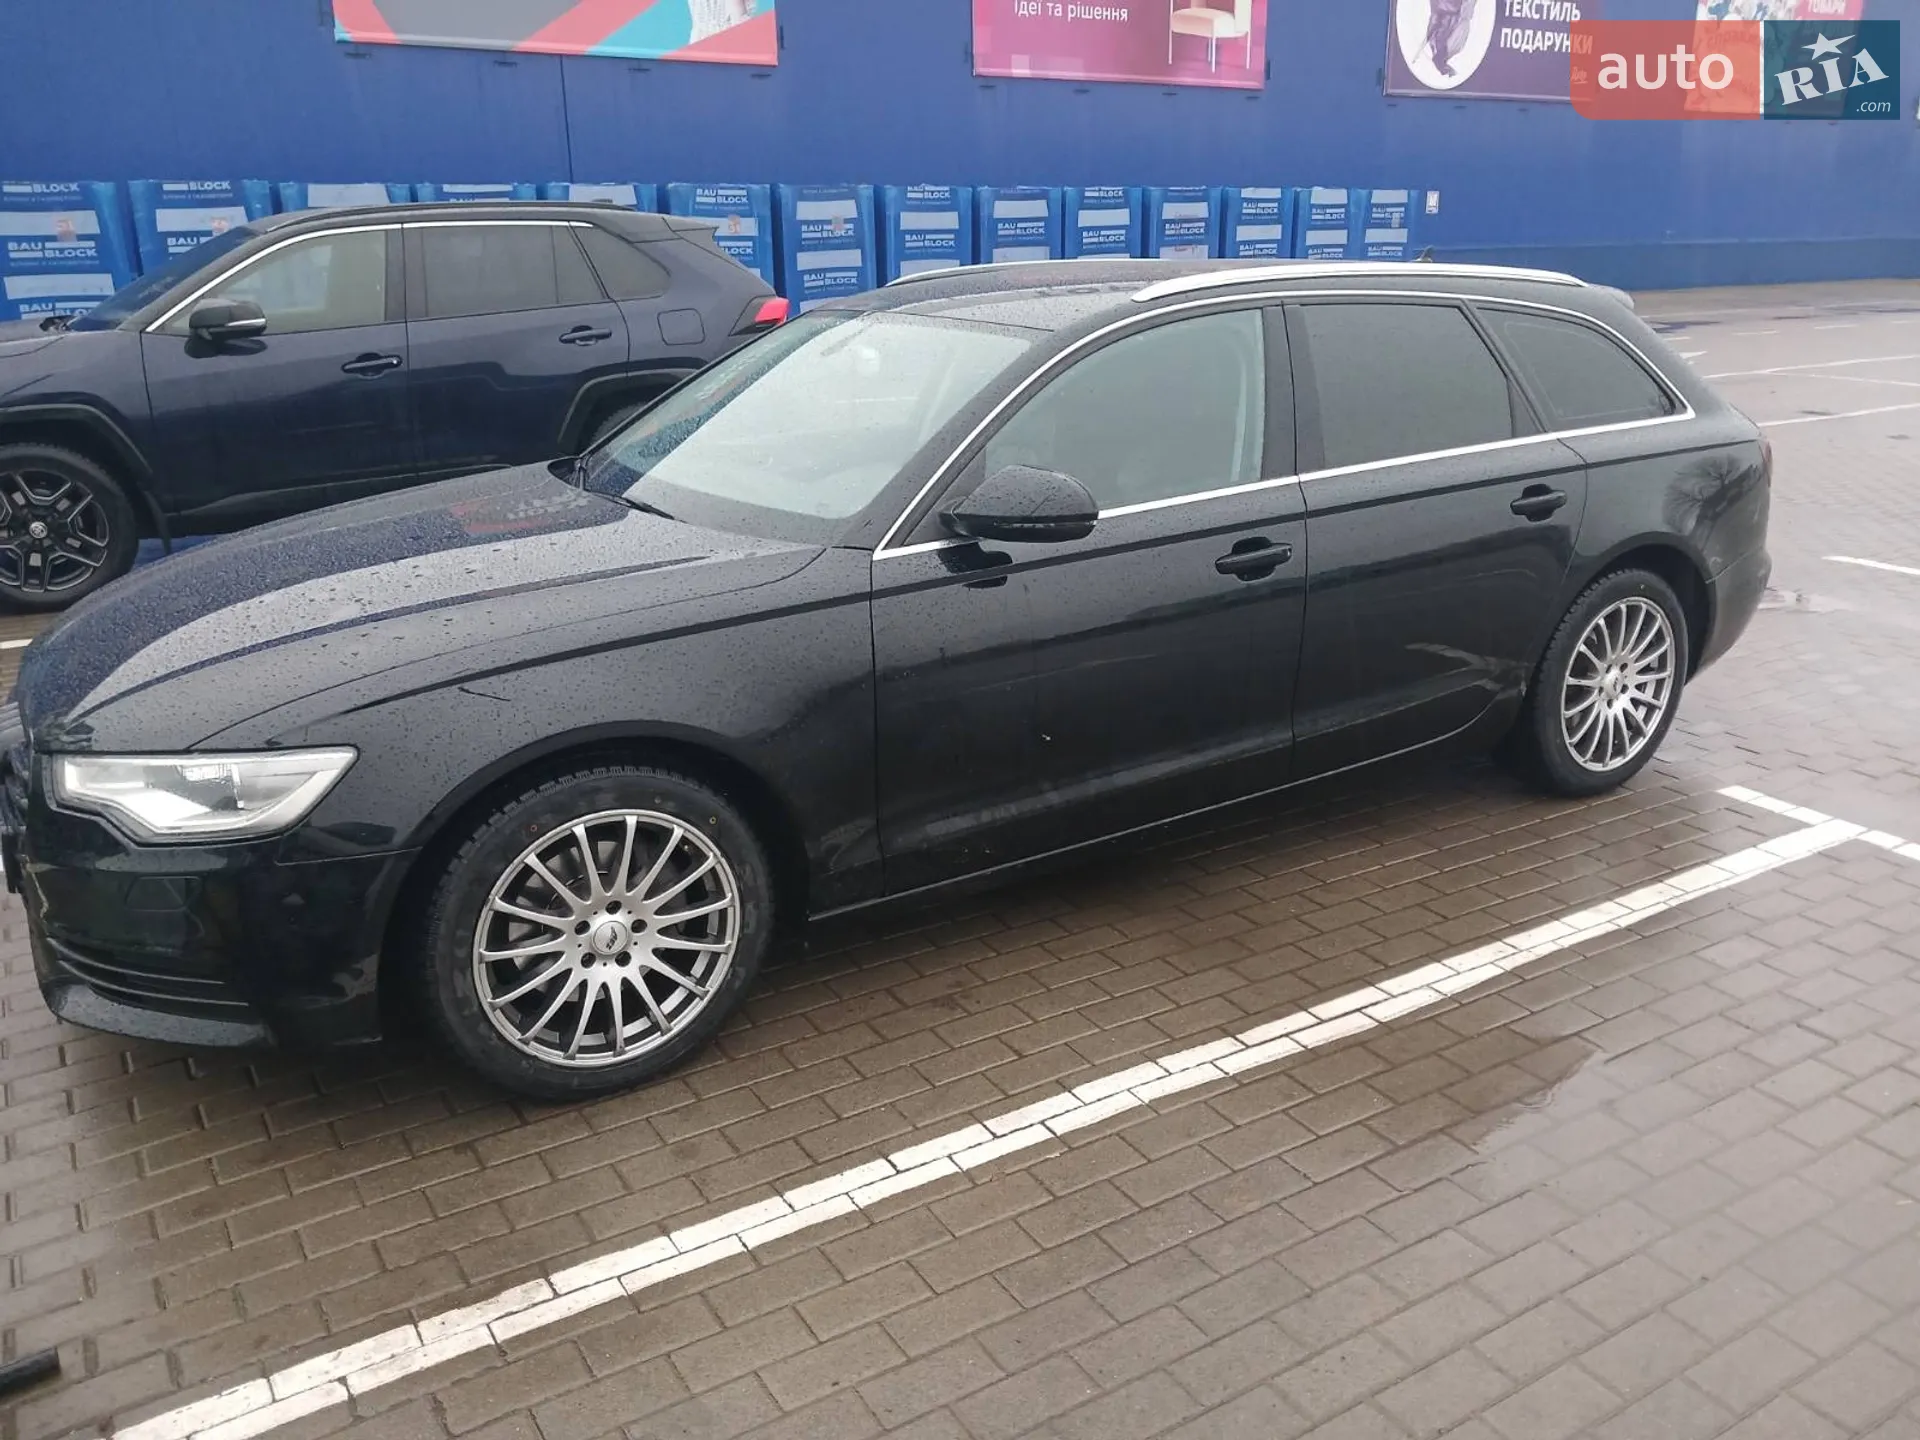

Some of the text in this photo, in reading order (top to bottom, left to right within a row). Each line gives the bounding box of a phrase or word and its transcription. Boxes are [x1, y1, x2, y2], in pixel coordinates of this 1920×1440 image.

[1047, 2, 1062, 17] та
[1067, 2, 1128, 22] рішення
[1504, 0, 1581, 22] ТЕКСТИЛЬ
[1500, 27, 1593, 55] ПОДАРУНКИ
[33, 183, 80, 193] BLOCK
[189, 181, 231, 191] BLOCK
[696, 188, 717, 196] BAU
[997, 222, 1016, 230] BAU
[8, 241, 42, 251] BAU
[167, 237, 197, 246] BAU
[44, 248, 98, 257] BLOCK
[804, 273, 825, 281] BAU
[825, 277, 858, 285] BLOCK
[19, 302, 53, 313] BAU
